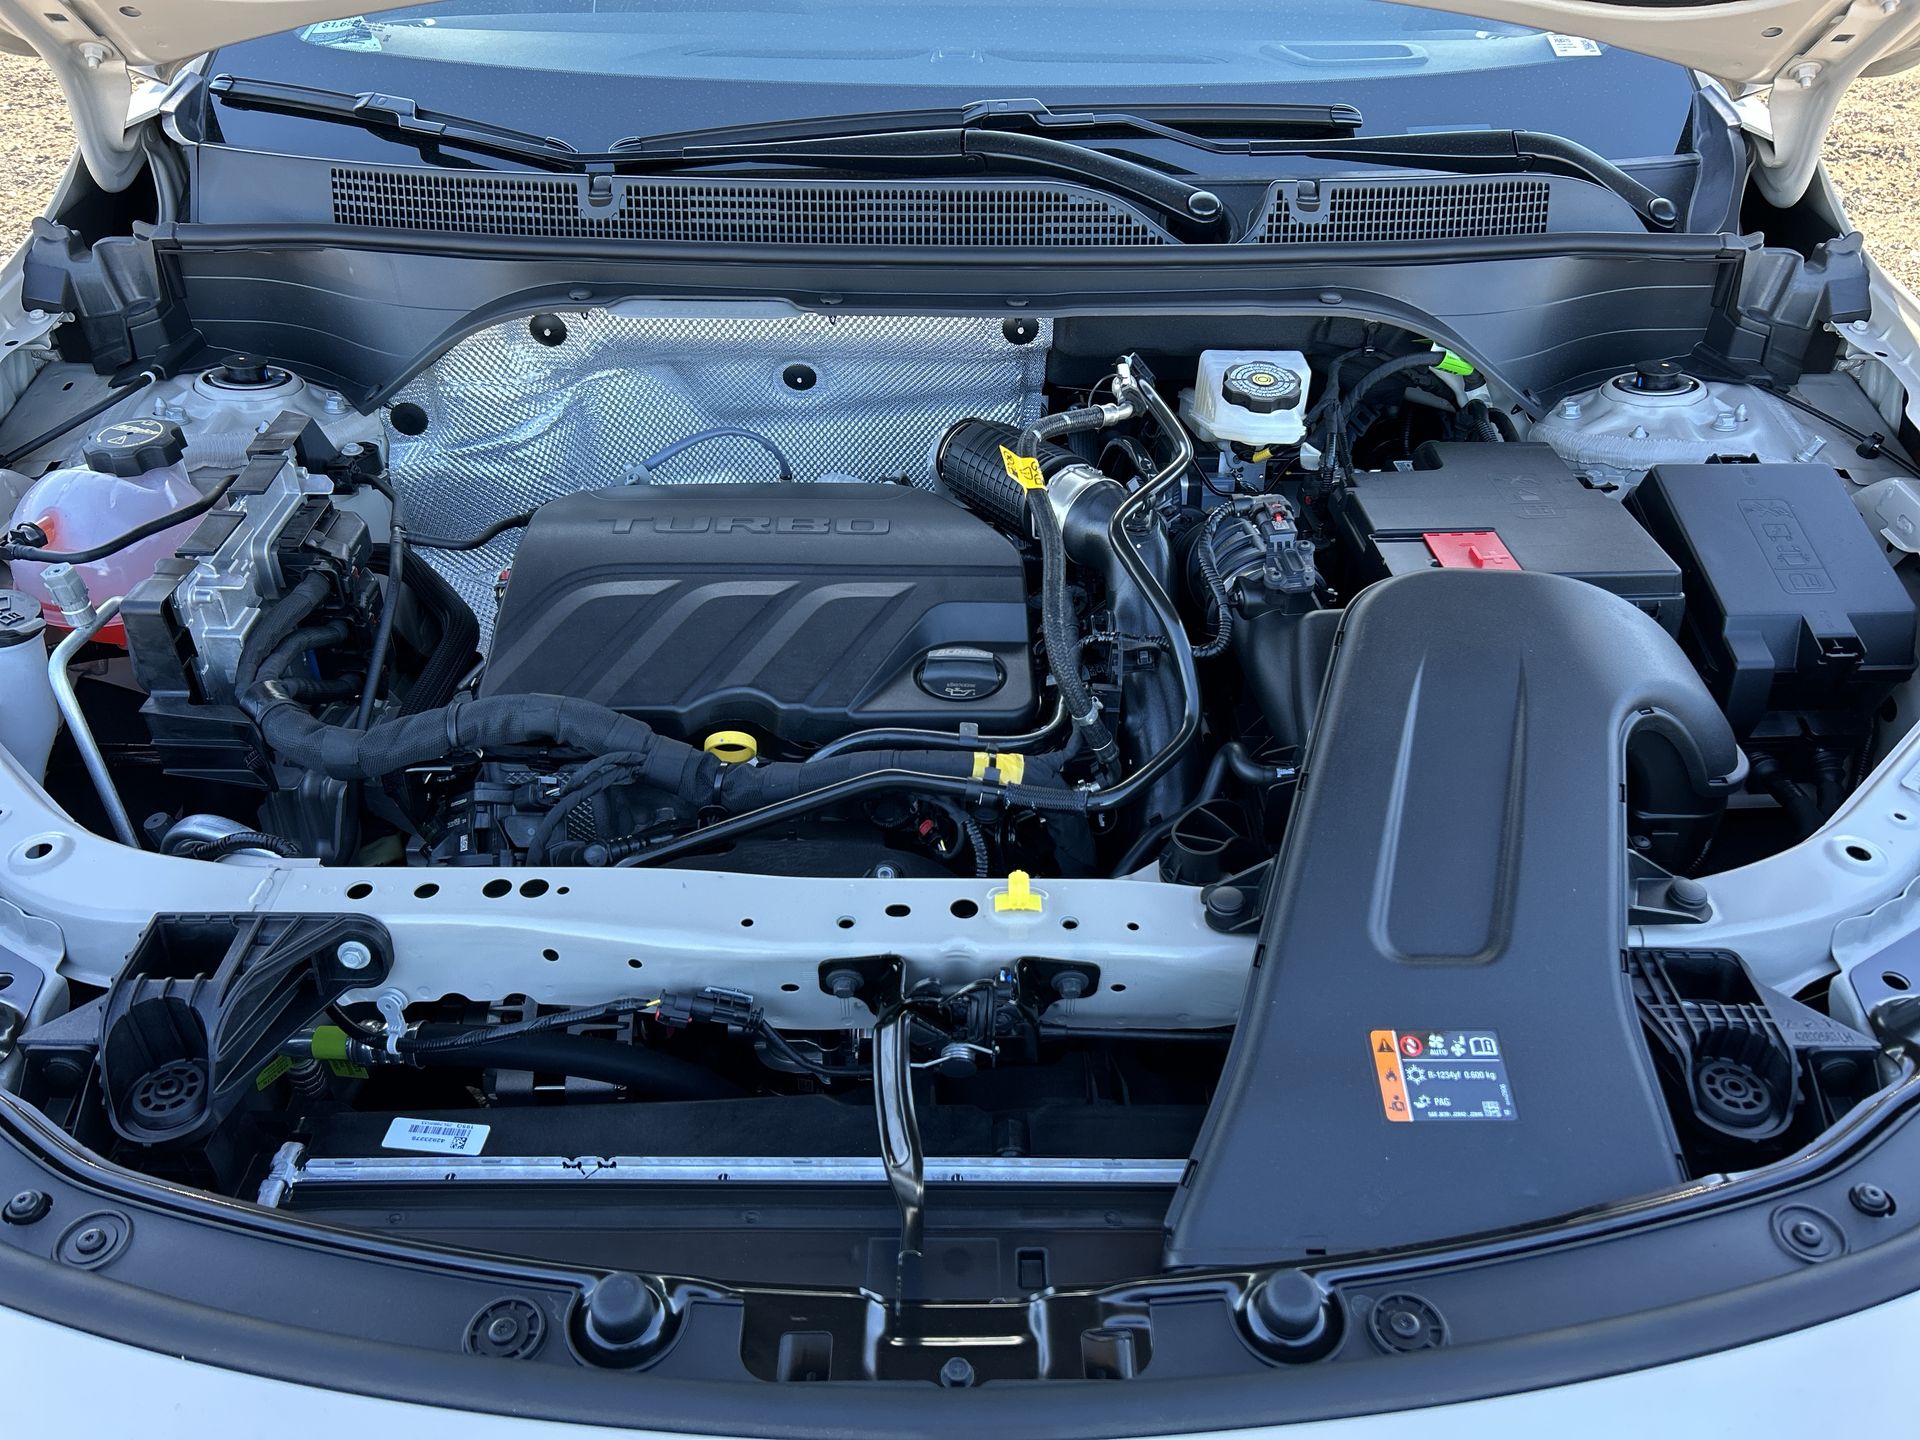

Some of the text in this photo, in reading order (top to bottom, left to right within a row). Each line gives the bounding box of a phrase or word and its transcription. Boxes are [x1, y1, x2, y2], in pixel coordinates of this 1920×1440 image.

[598, 515, 891, 536] TURBO
[1427, 1070, 1497, 1081] R-1234yf 0.600 kg
[1433, 1097, 1451, 1107] PAG
